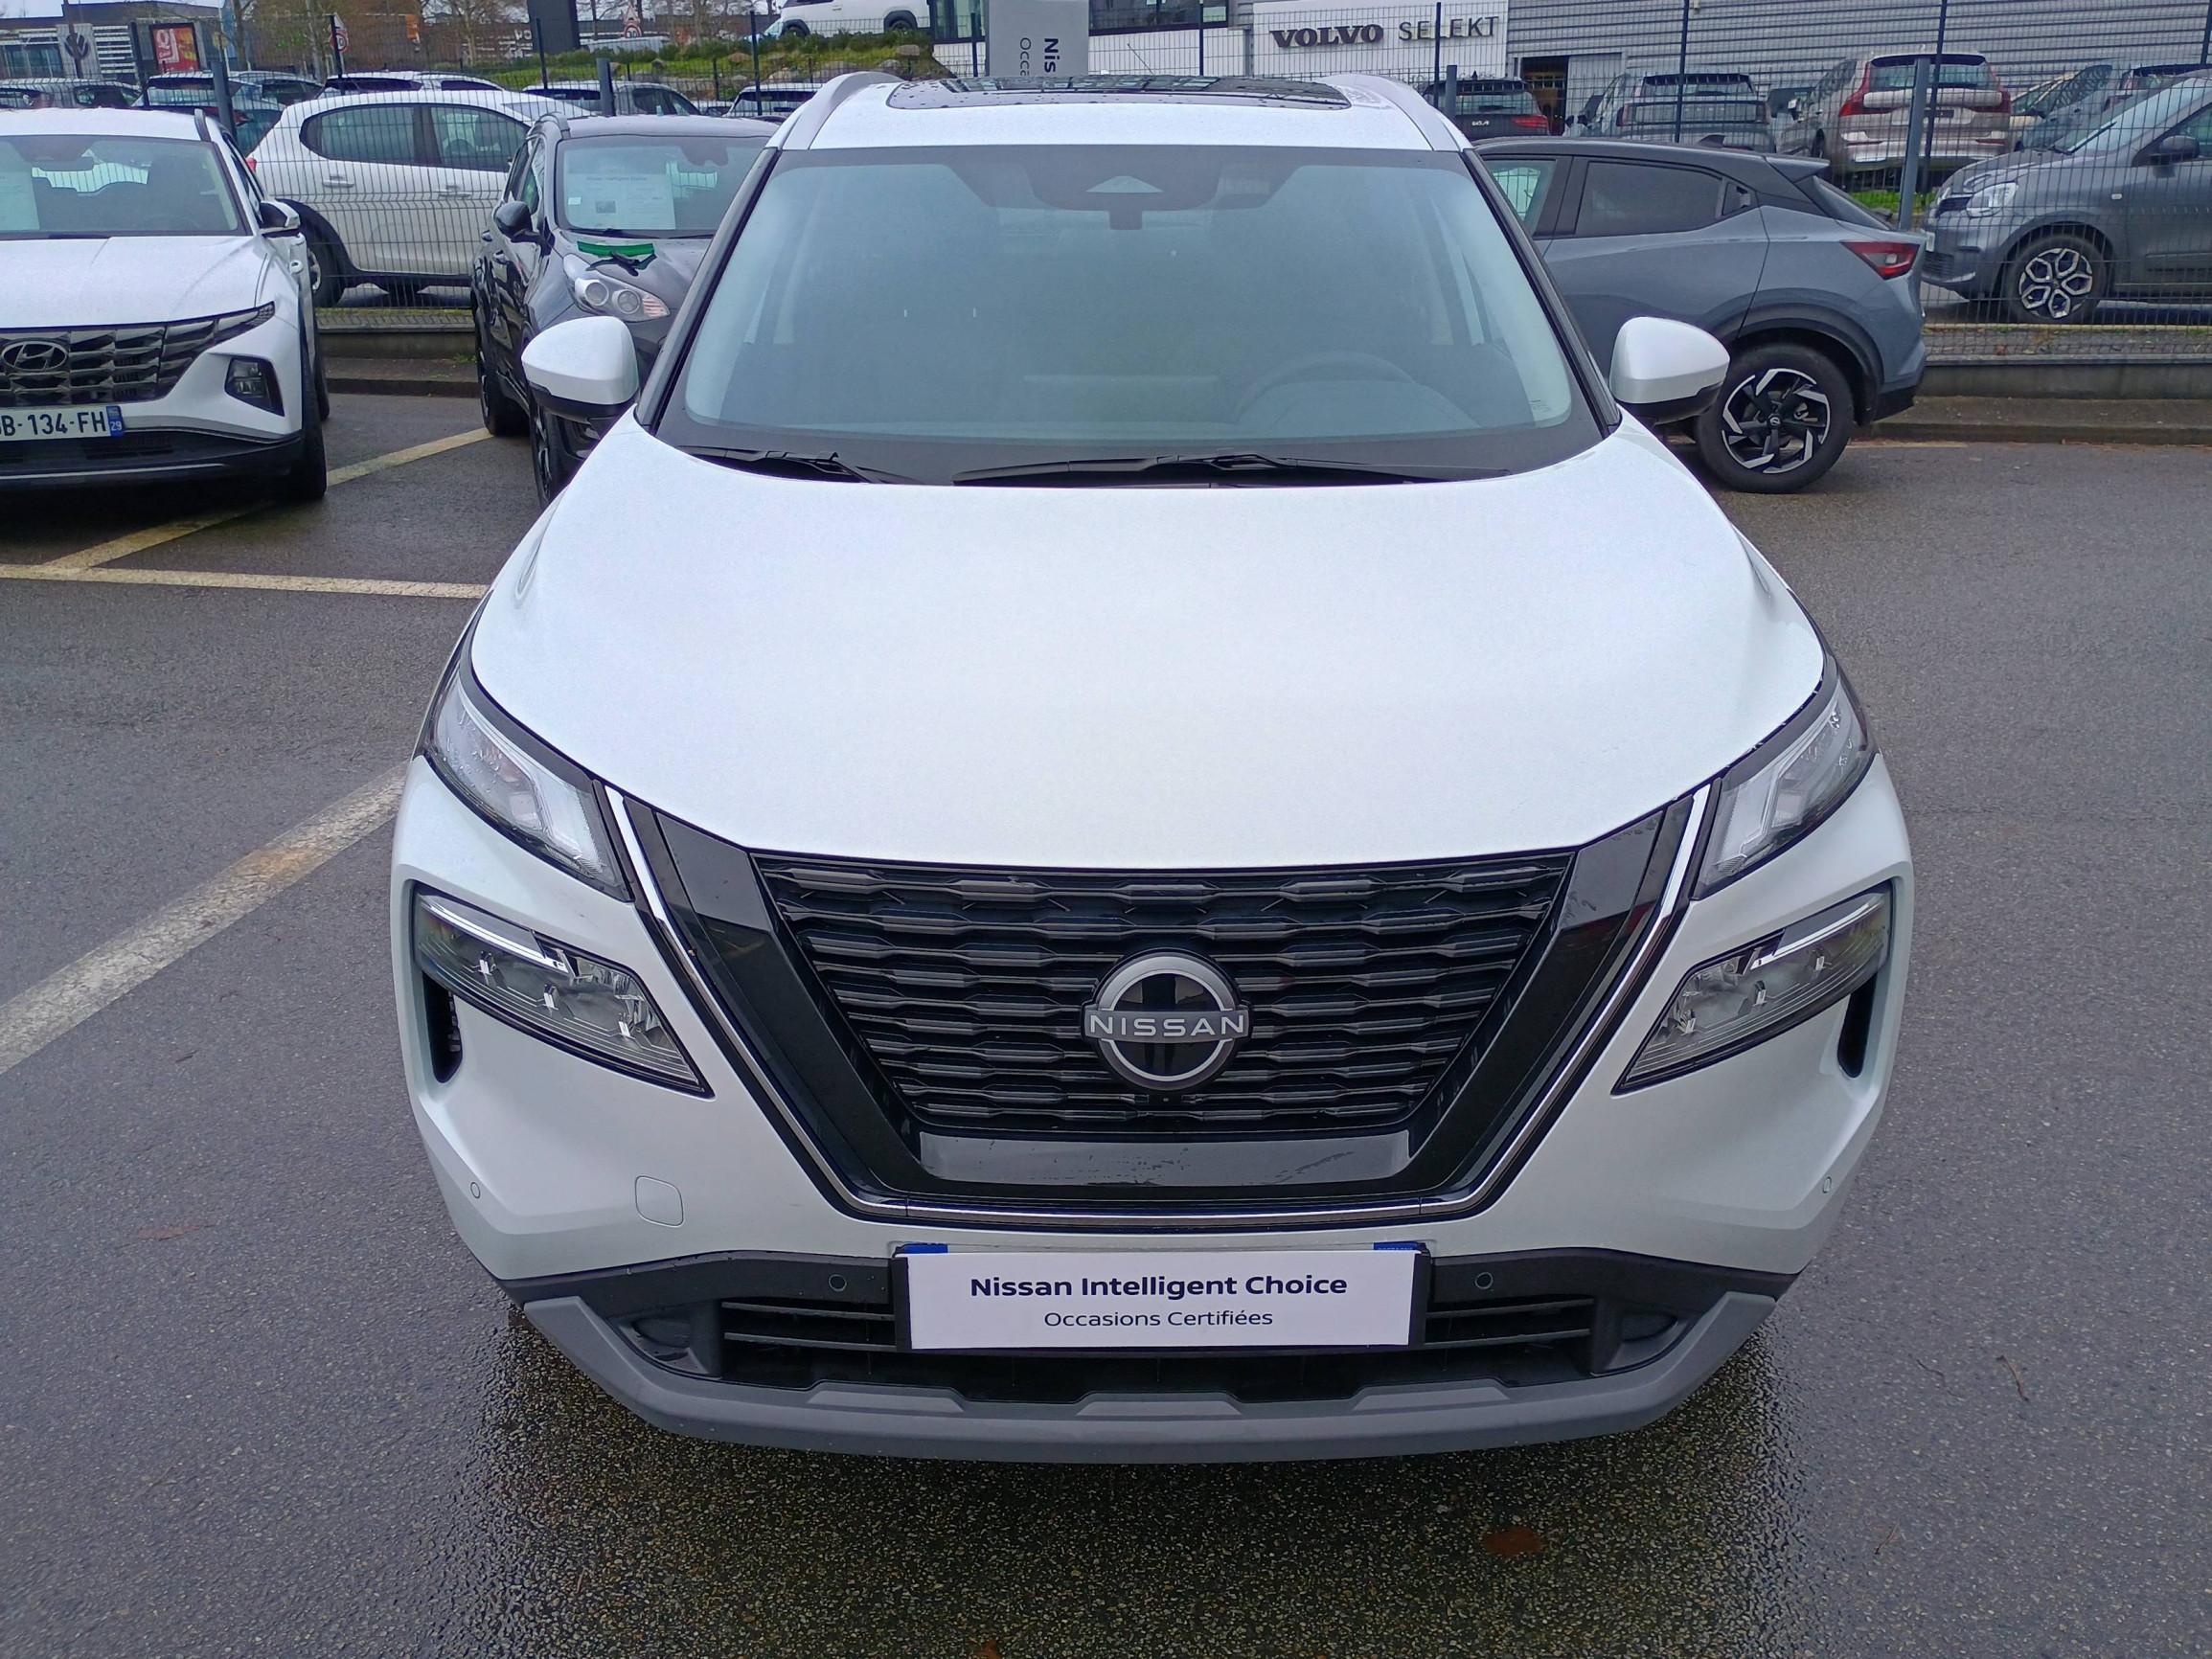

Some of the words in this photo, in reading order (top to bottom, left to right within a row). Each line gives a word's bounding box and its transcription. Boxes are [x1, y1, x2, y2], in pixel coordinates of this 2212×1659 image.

[1269, 24, 1384, 48] VOLVO
[1044, 38, 1060, 73] Nis
[0, 411, 106, 436] B-134-FH
[110, 421, 123, 431] 29
[1090, 1014, 1243, 1037] NISSAN
[970, 1278, 1073, 1297] Nissan
[1082, 1276, 1238, 1300] Intelligent
[1245, 1275, 1348, 1295] Choice
[1044, 1312, 1161, 1328] Occasions
[1167, 1309, 1274, 1327] Certifiées
